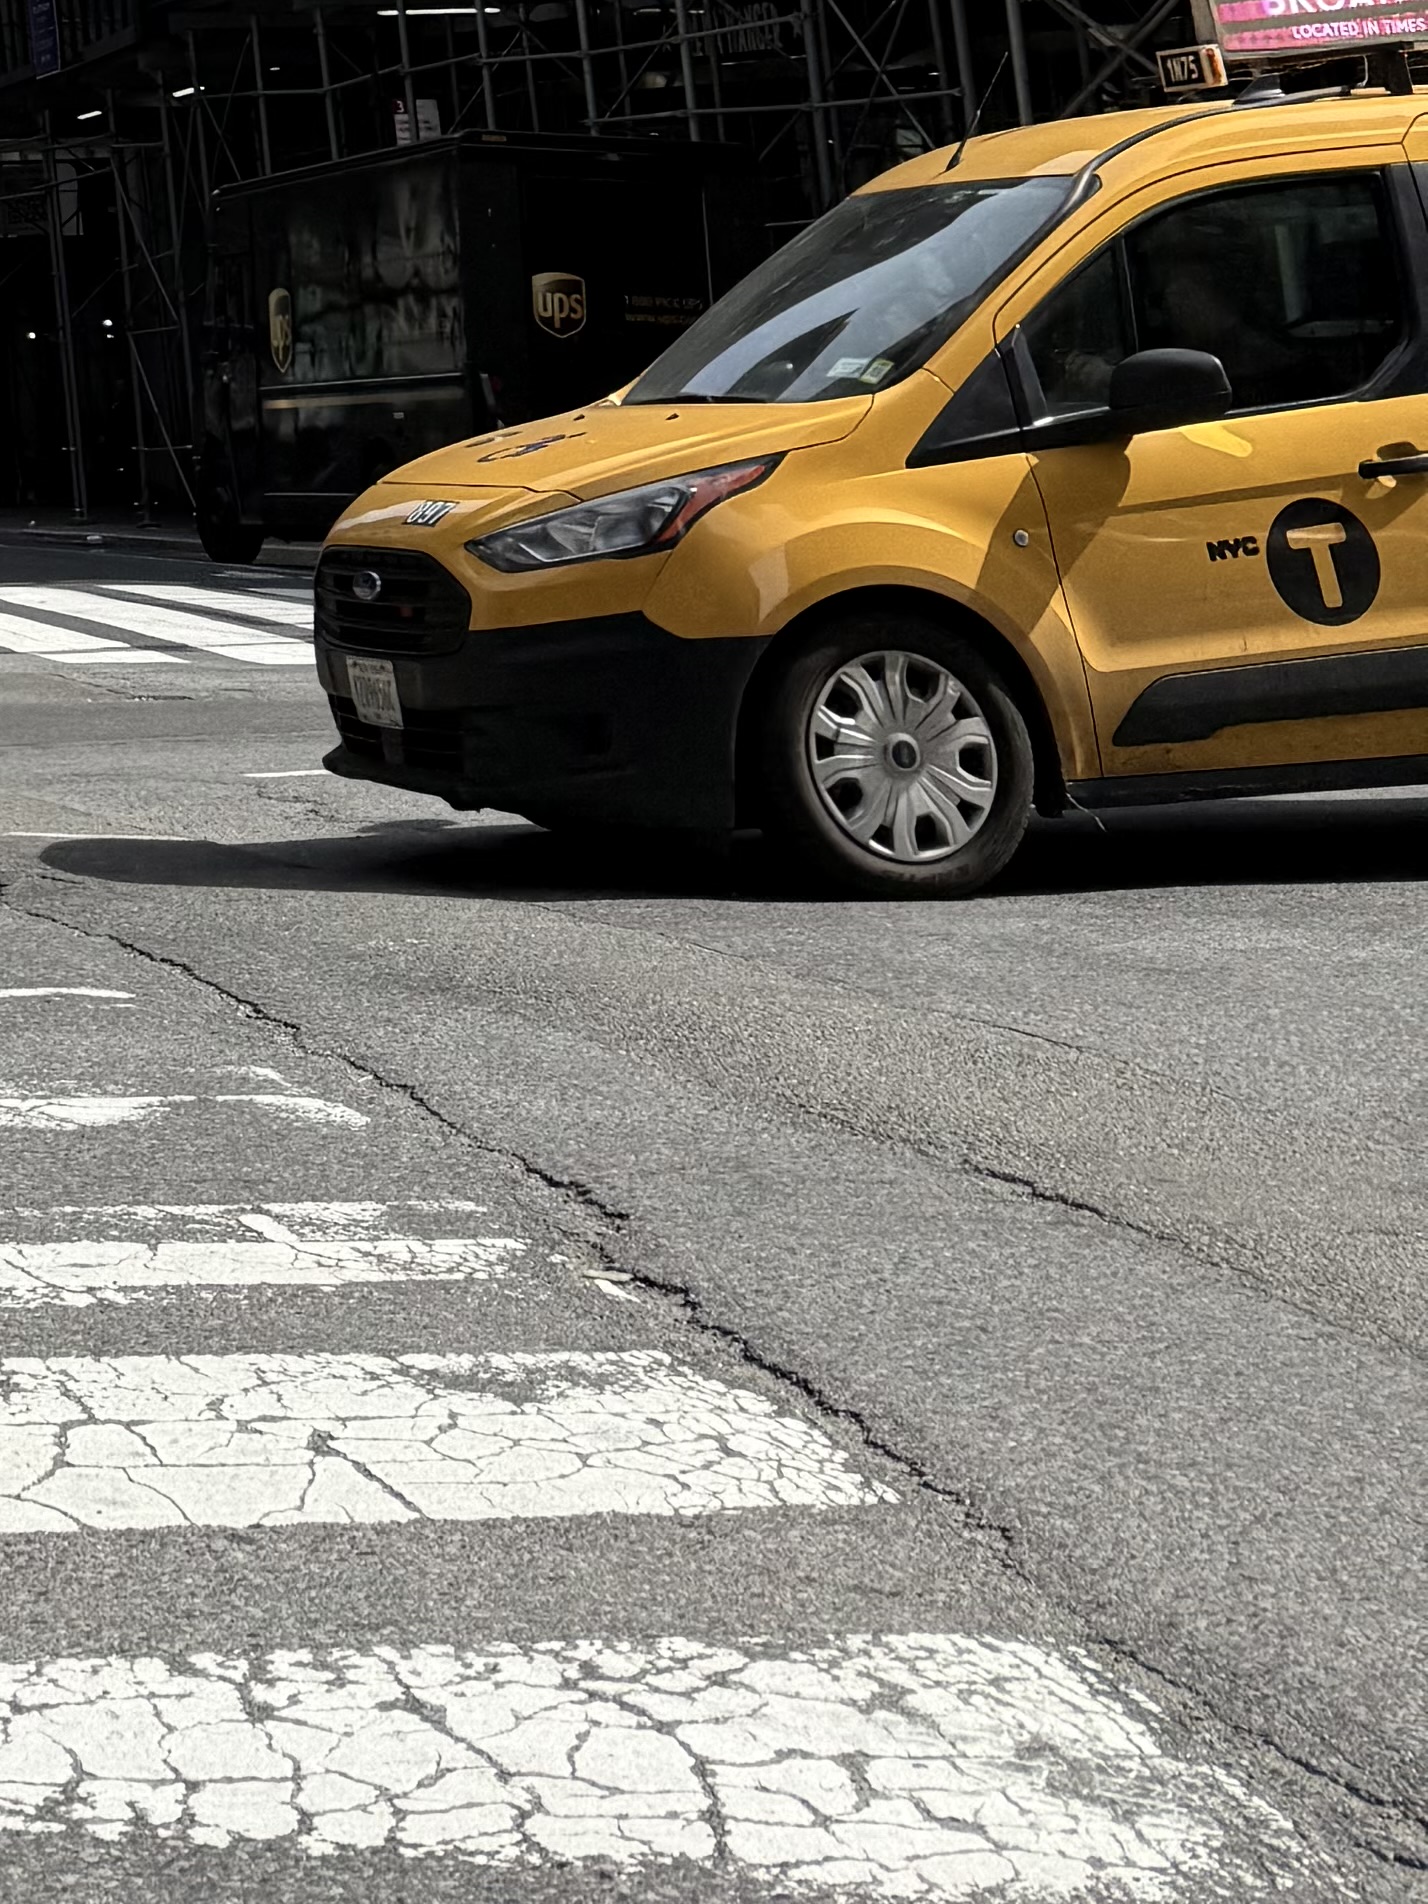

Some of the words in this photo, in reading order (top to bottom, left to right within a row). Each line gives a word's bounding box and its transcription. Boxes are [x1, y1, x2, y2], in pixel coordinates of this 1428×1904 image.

[1291, 21, 1359, 40] LOCATED
[1363, 20, 1379, 36] IN
[1383, 17, 1427, 35] TIMES
[536, 291, 584, 329] ups
[1206, 535, 1260, 562] NYC
[1285, 521, 1347, 609] T
